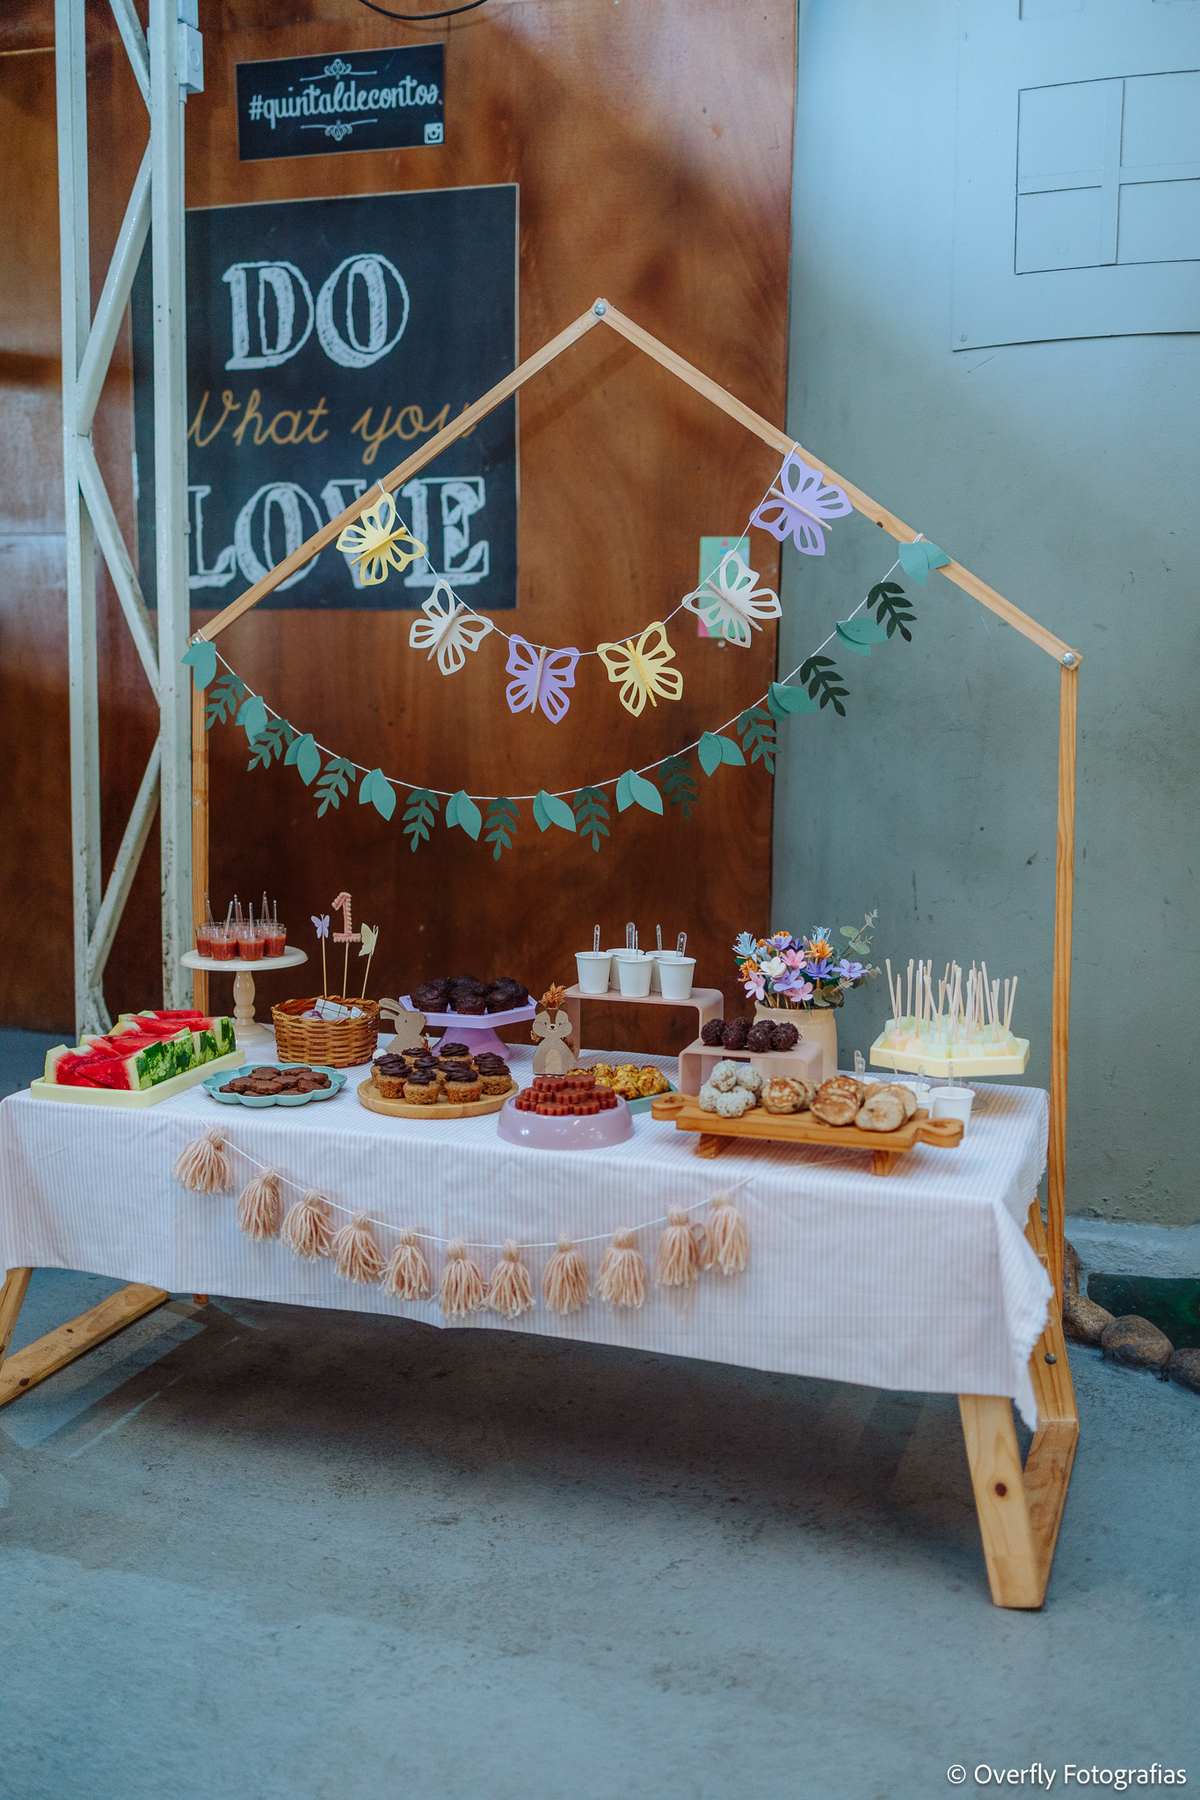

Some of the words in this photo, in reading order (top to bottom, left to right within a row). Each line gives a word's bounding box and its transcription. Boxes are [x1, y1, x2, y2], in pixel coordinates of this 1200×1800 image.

[248, 75, 439, 130] #quintaldecontos
[222, 253, 410, 371] DO
[187, 388, 329, 447] What
[331, 892, 361, 942] 1
